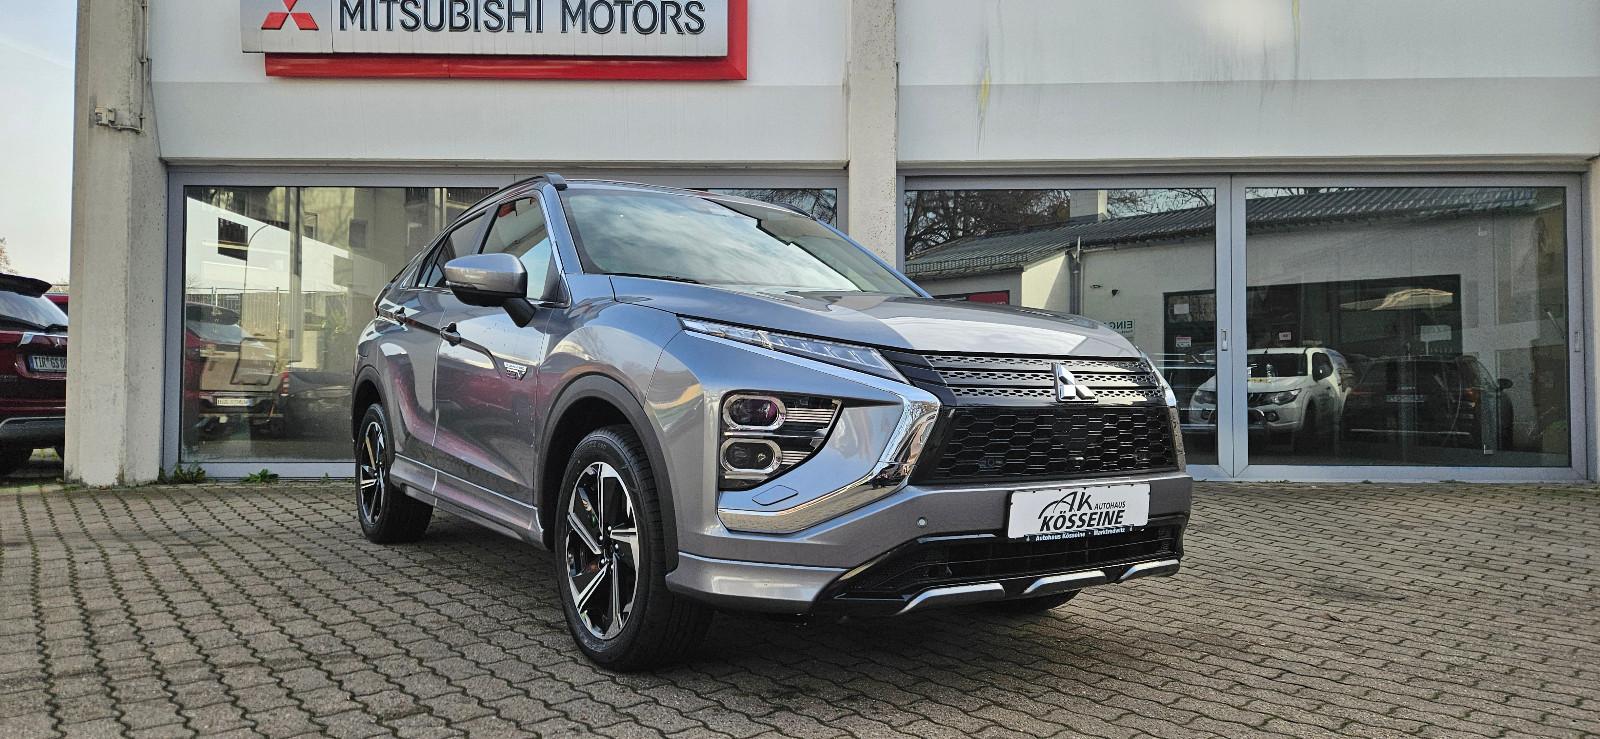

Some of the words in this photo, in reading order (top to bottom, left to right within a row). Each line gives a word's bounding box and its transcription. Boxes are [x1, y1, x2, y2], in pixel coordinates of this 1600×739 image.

[339, 0, 544, 34] MITSUBISHI
[561, 0, 706, 35] MOTORS
[1093, 501, 1126, 511] AUTOHAUS
[1039, 508, 1126, 532] KÖSSEINE
[1035, 534, 1061, 542] Autohaus
